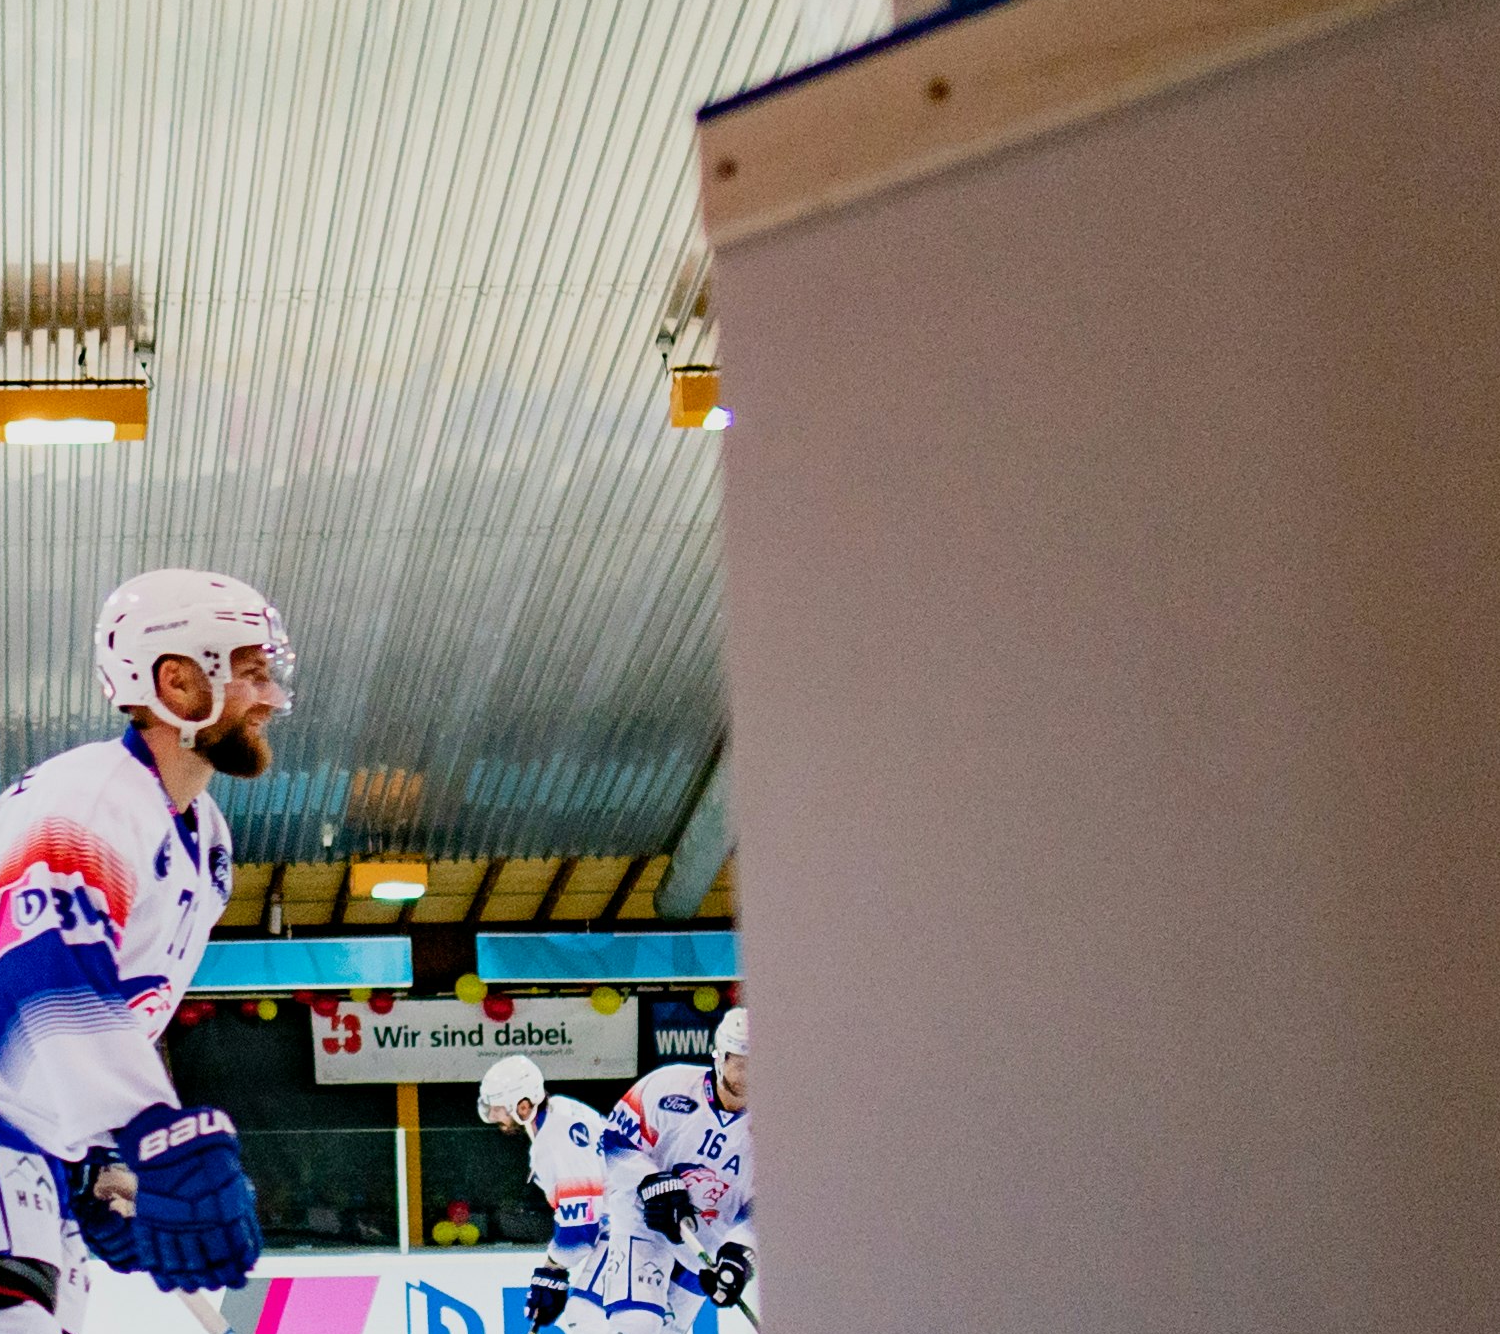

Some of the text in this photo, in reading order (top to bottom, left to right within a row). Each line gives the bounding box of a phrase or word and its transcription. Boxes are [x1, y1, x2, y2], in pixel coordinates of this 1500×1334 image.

[373, 1021, 573, 1049] Wir sind dabei.
[663, 1096, 693, 1114] Ford
[697, 1128, 727, 1160] 16
[721, 1154, 741, 1176] A
